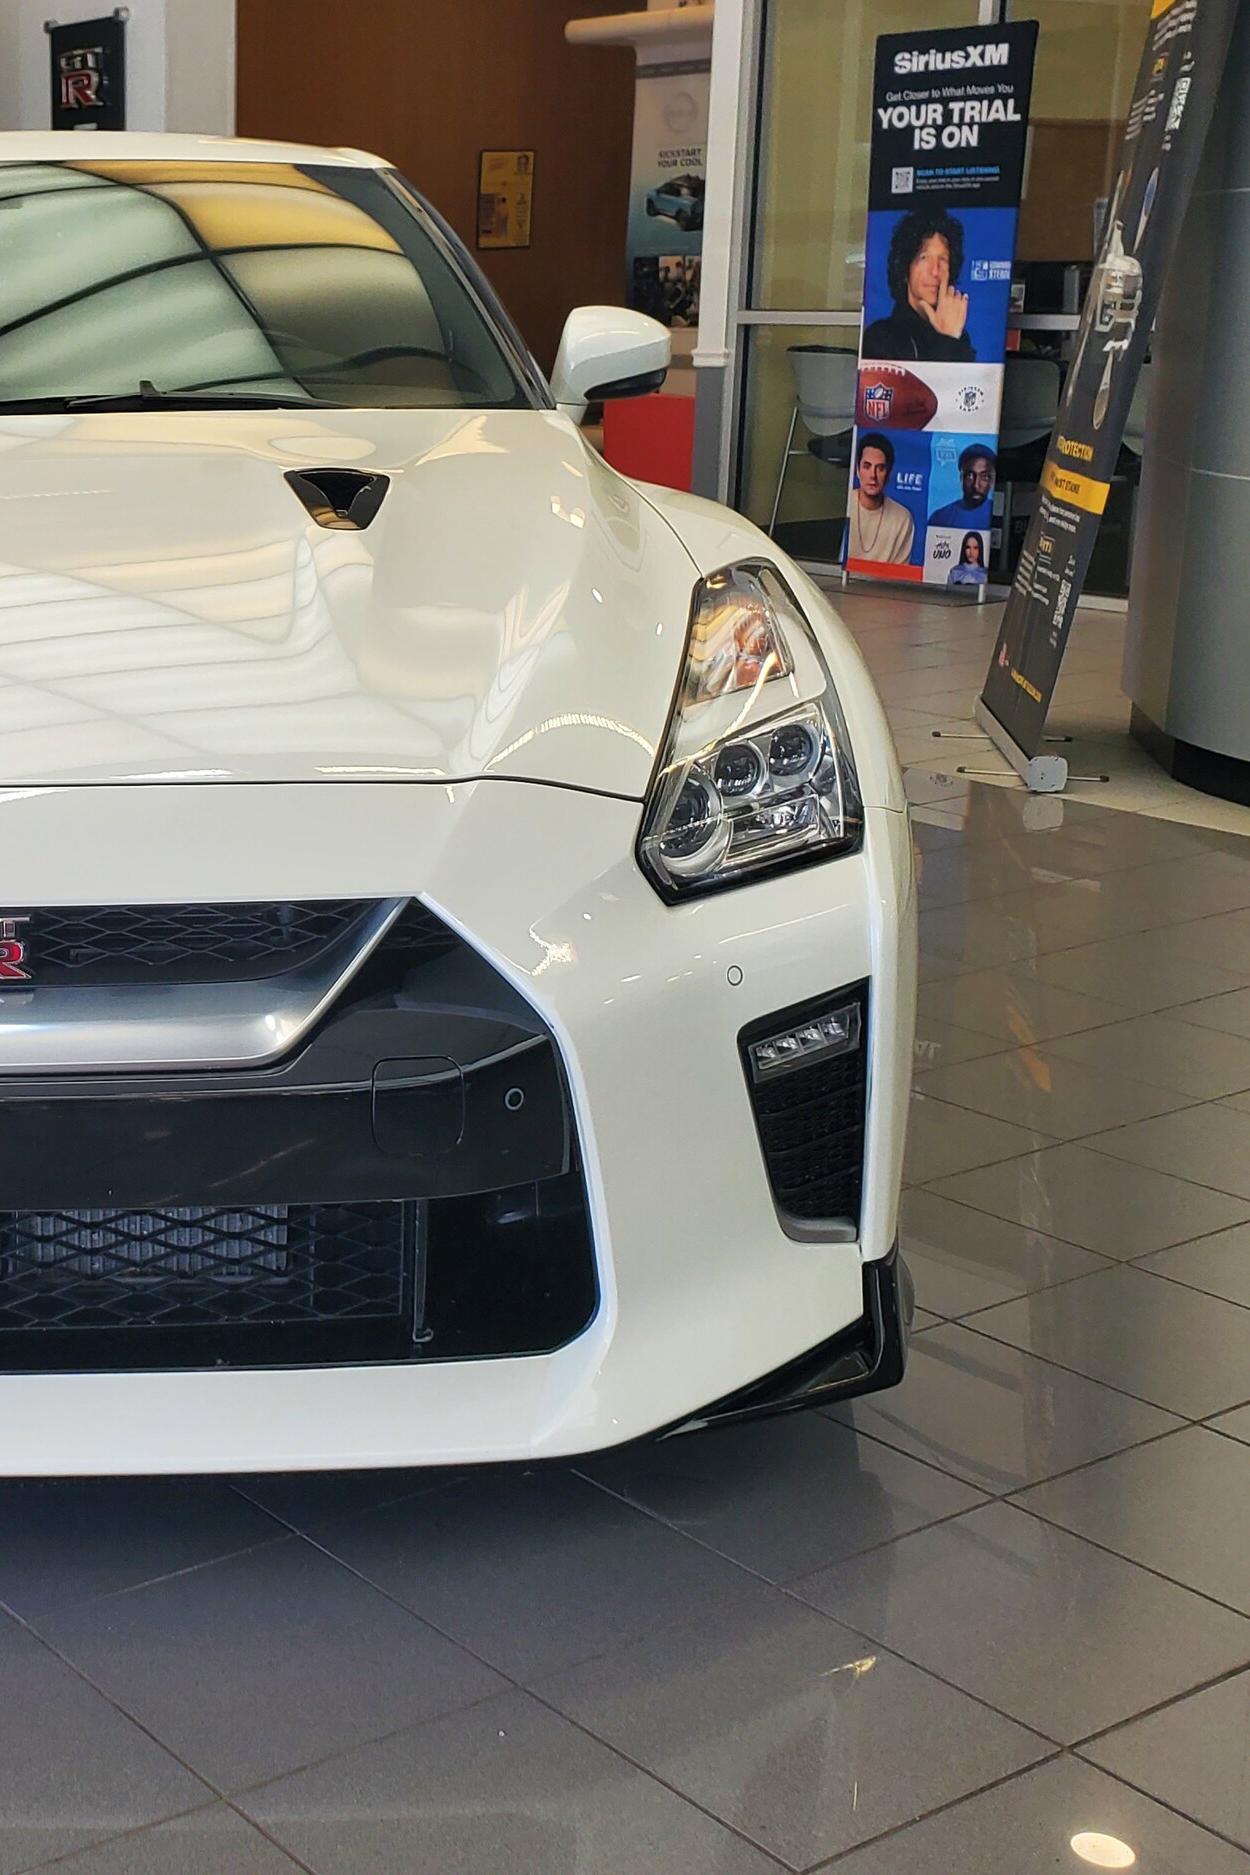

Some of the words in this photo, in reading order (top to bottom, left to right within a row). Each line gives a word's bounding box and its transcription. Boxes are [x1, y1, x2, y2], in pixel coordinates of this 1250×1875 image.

[893, 43, 1010, 74] SiriusXM
[886, 91, 902, 102] Get
[903, 90, 930, 101] Closer
[931, 88, 941, 98] to
[942, 86, 965, 97] What
[966, 84, 996, 96] Moves
[996, 83, 1014, 94] You
[877, 103, 943, 130] YOUR
[949, 98, 1021, 124] TRIAL
[914, 127, 937, 150] IS
[941, 124, 979, 149] ON
[657, 159, 678, 168] YOUR
[680, 158, 703, 167] COOL
[867, 401, 887, 418] NFL
[896, 472, 923, 486] LIFE
